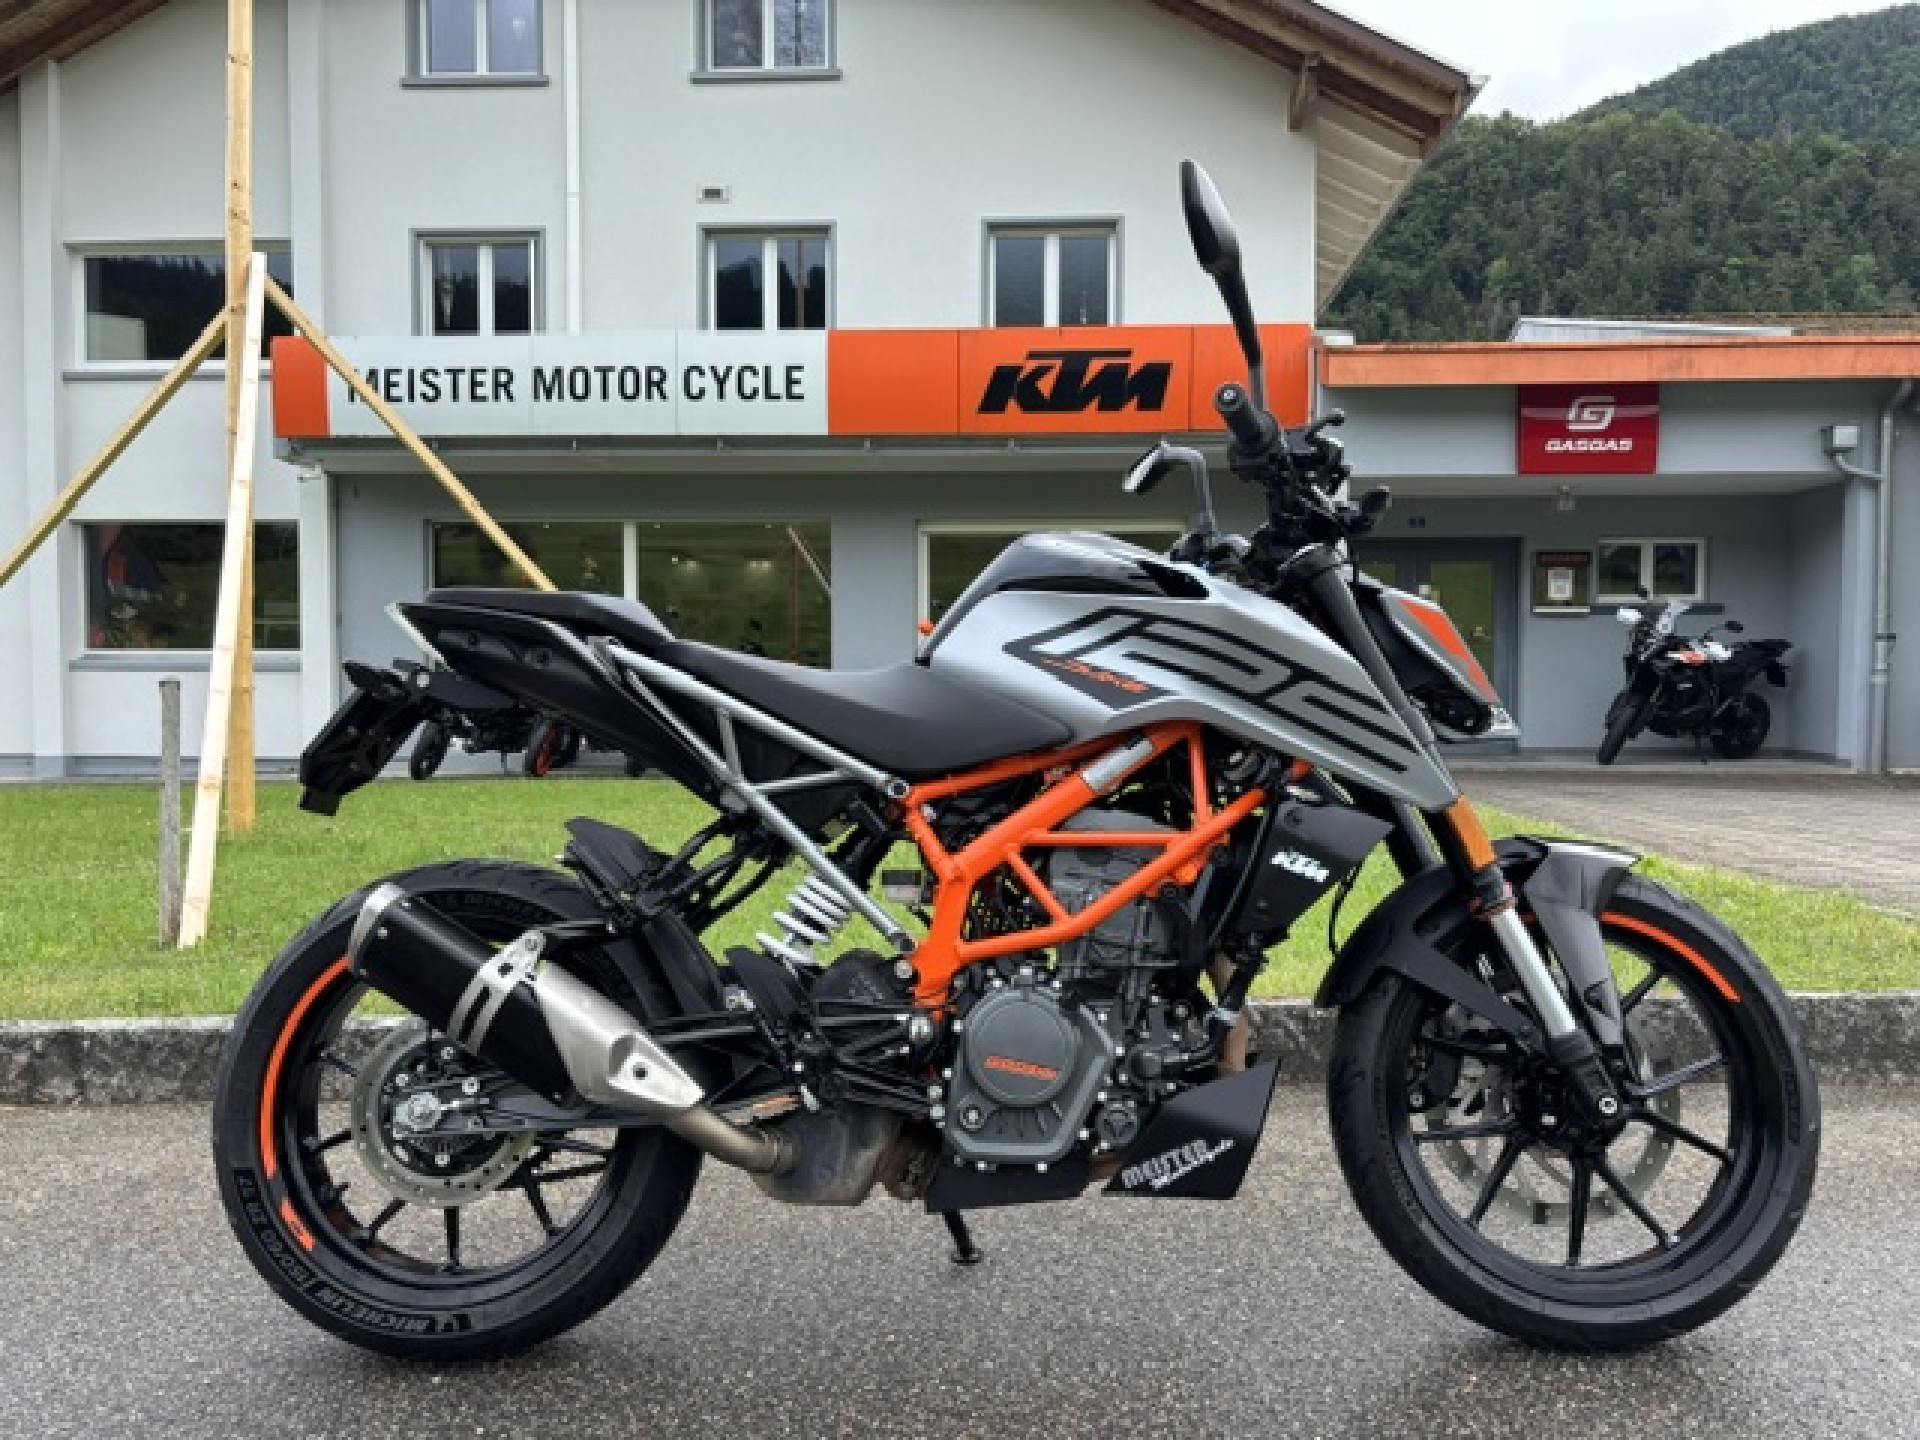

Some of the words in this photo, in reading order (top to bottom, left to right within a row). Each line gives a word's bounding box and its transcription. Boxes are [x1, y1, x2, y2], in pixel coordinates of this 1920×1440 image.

[532, 365, 668, 403] MOTOR
[683, 365, 805, 402] CYCLE
[978, 348, 1173, 414] KTM
[1544, 437, 1633, 453] GASGAS
[1269, 850, 1330, 883] KTM
